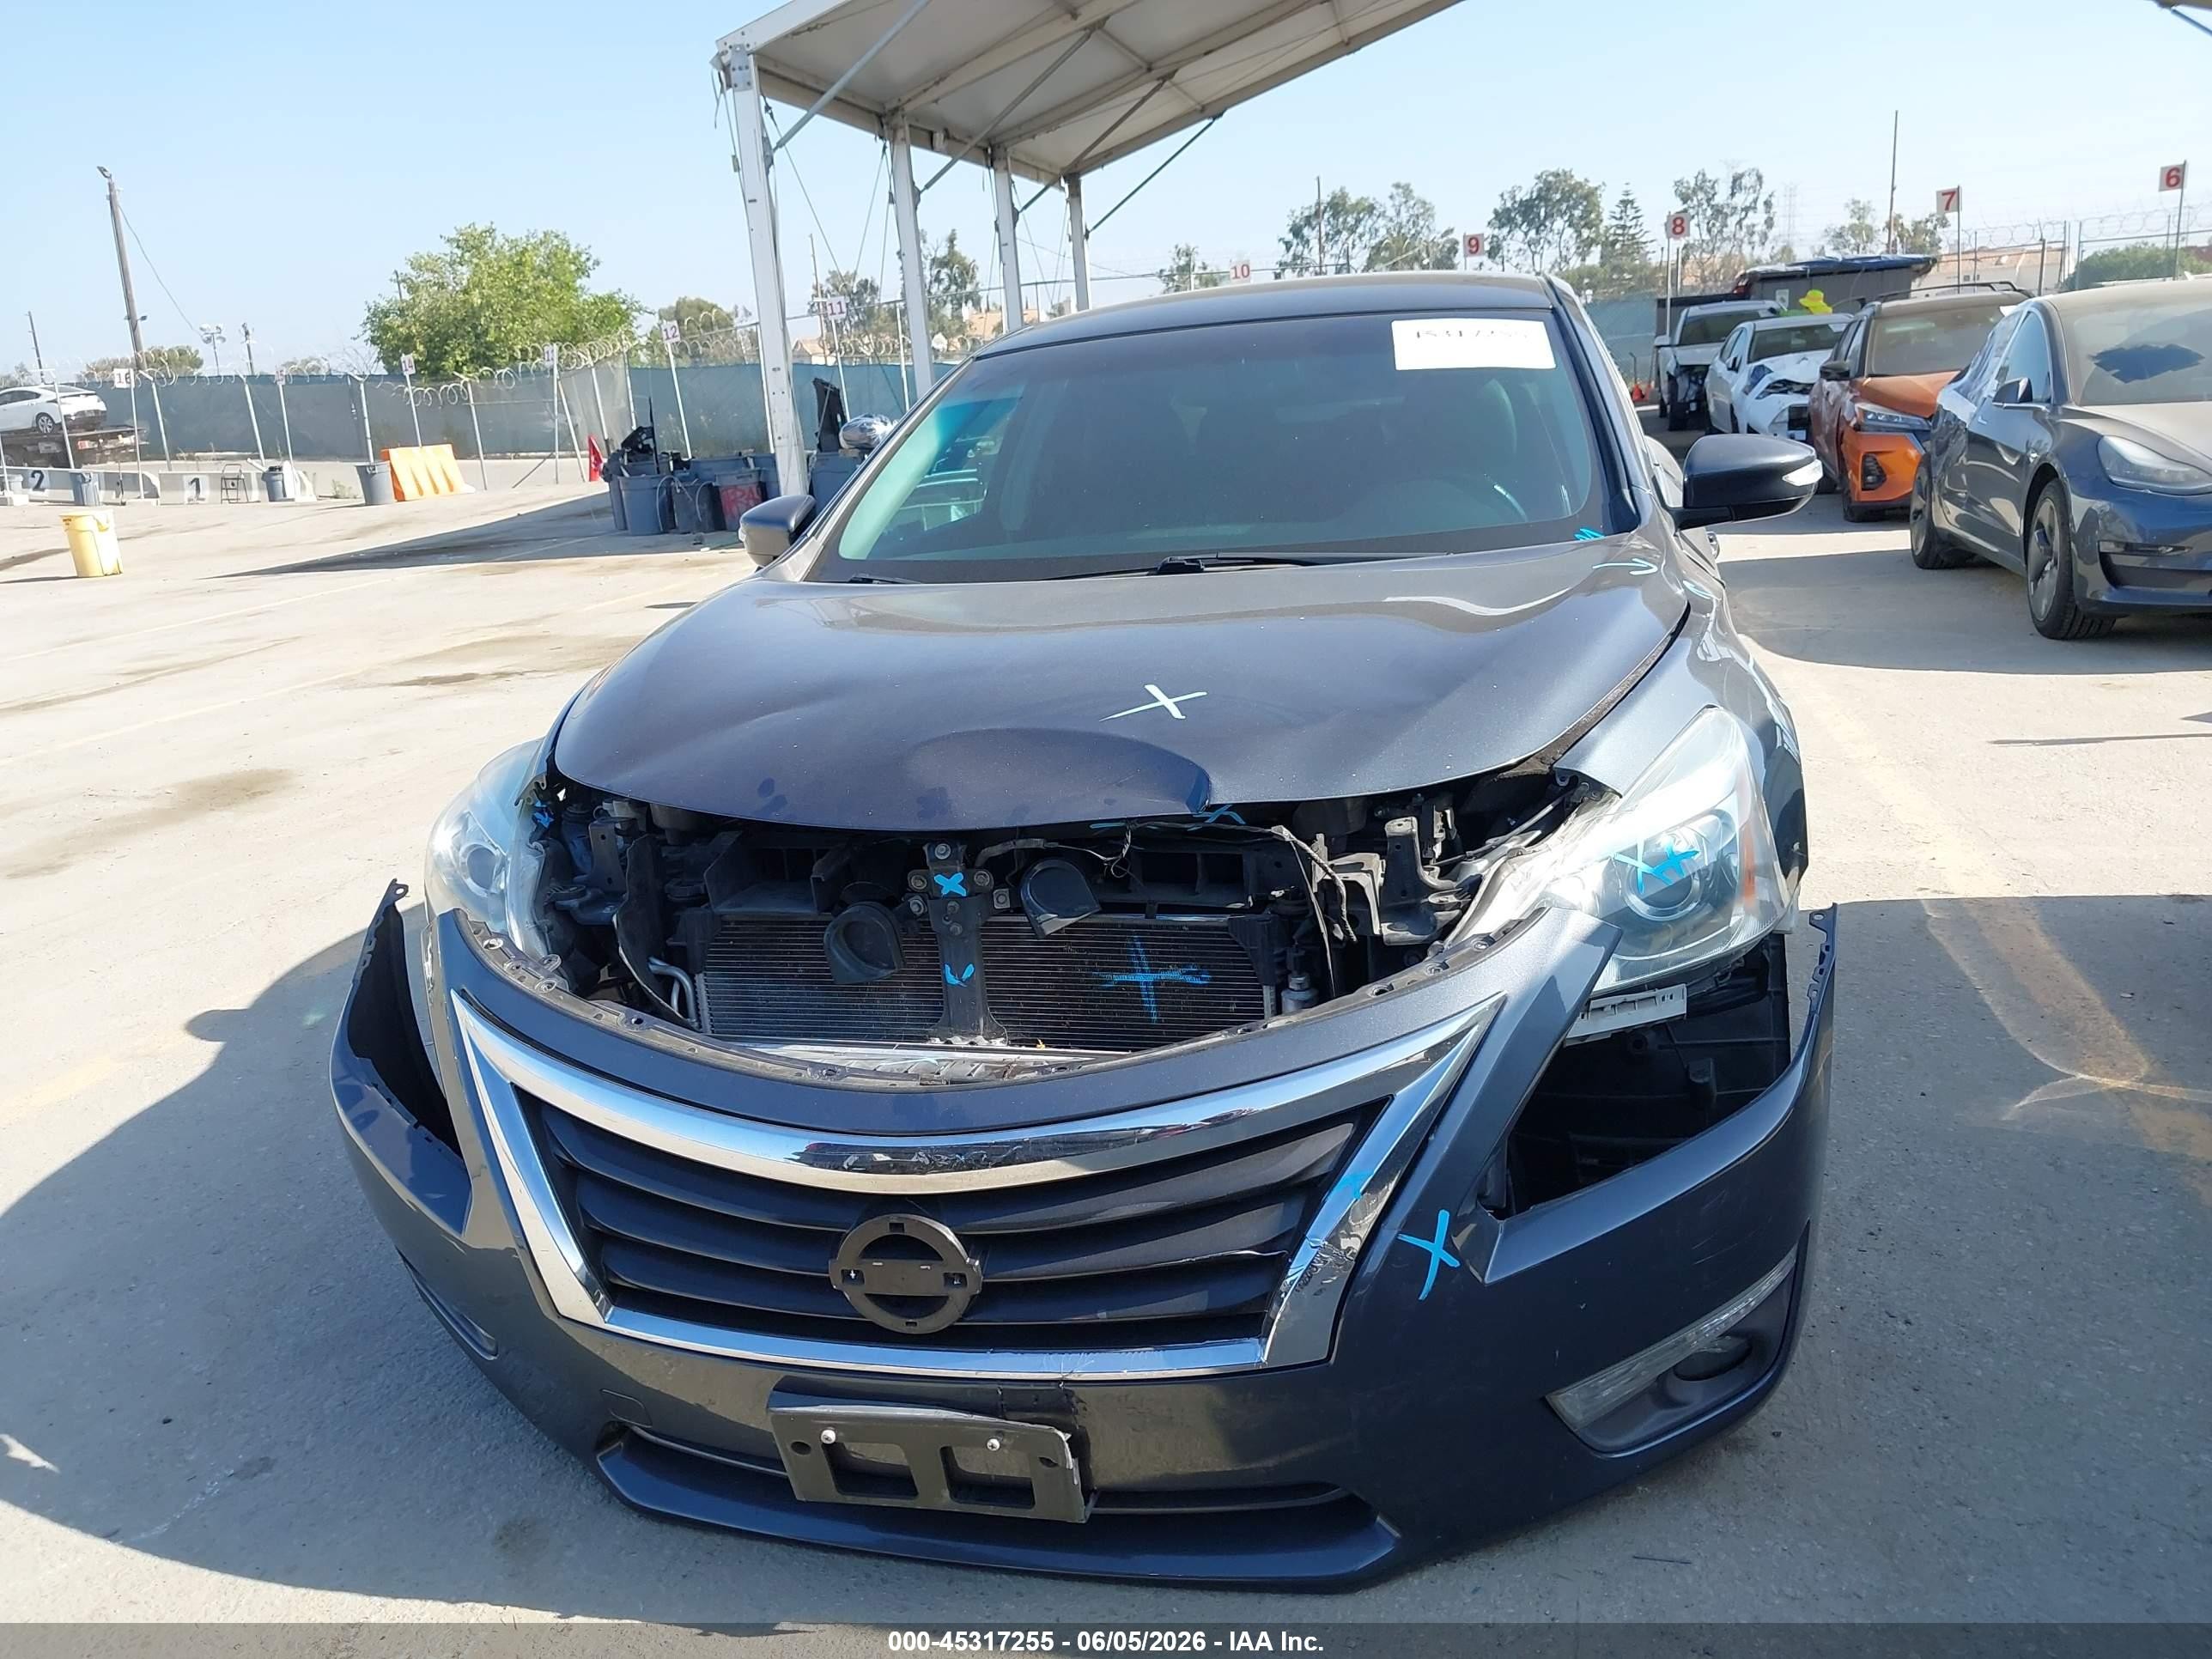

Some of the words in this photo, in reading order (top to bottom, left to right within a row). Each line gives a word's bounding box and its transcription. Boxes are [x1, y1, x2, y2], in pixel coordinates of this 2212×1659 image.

[2165, 167, 2180, 188] 6
[1941, 191, 1956, 211] 7
[1671, 216, 1685, 235] 8
[1468, 236, 1480, 255] 9
[1230, 264, 1250, 280] 10
[828, 301, 845, 316] 11
[663, 325, 678, 341] 12
[402, 358, 413, 373] 14
[31, 470, 46, 492] 2
[188, 477, 206, 501] 1
